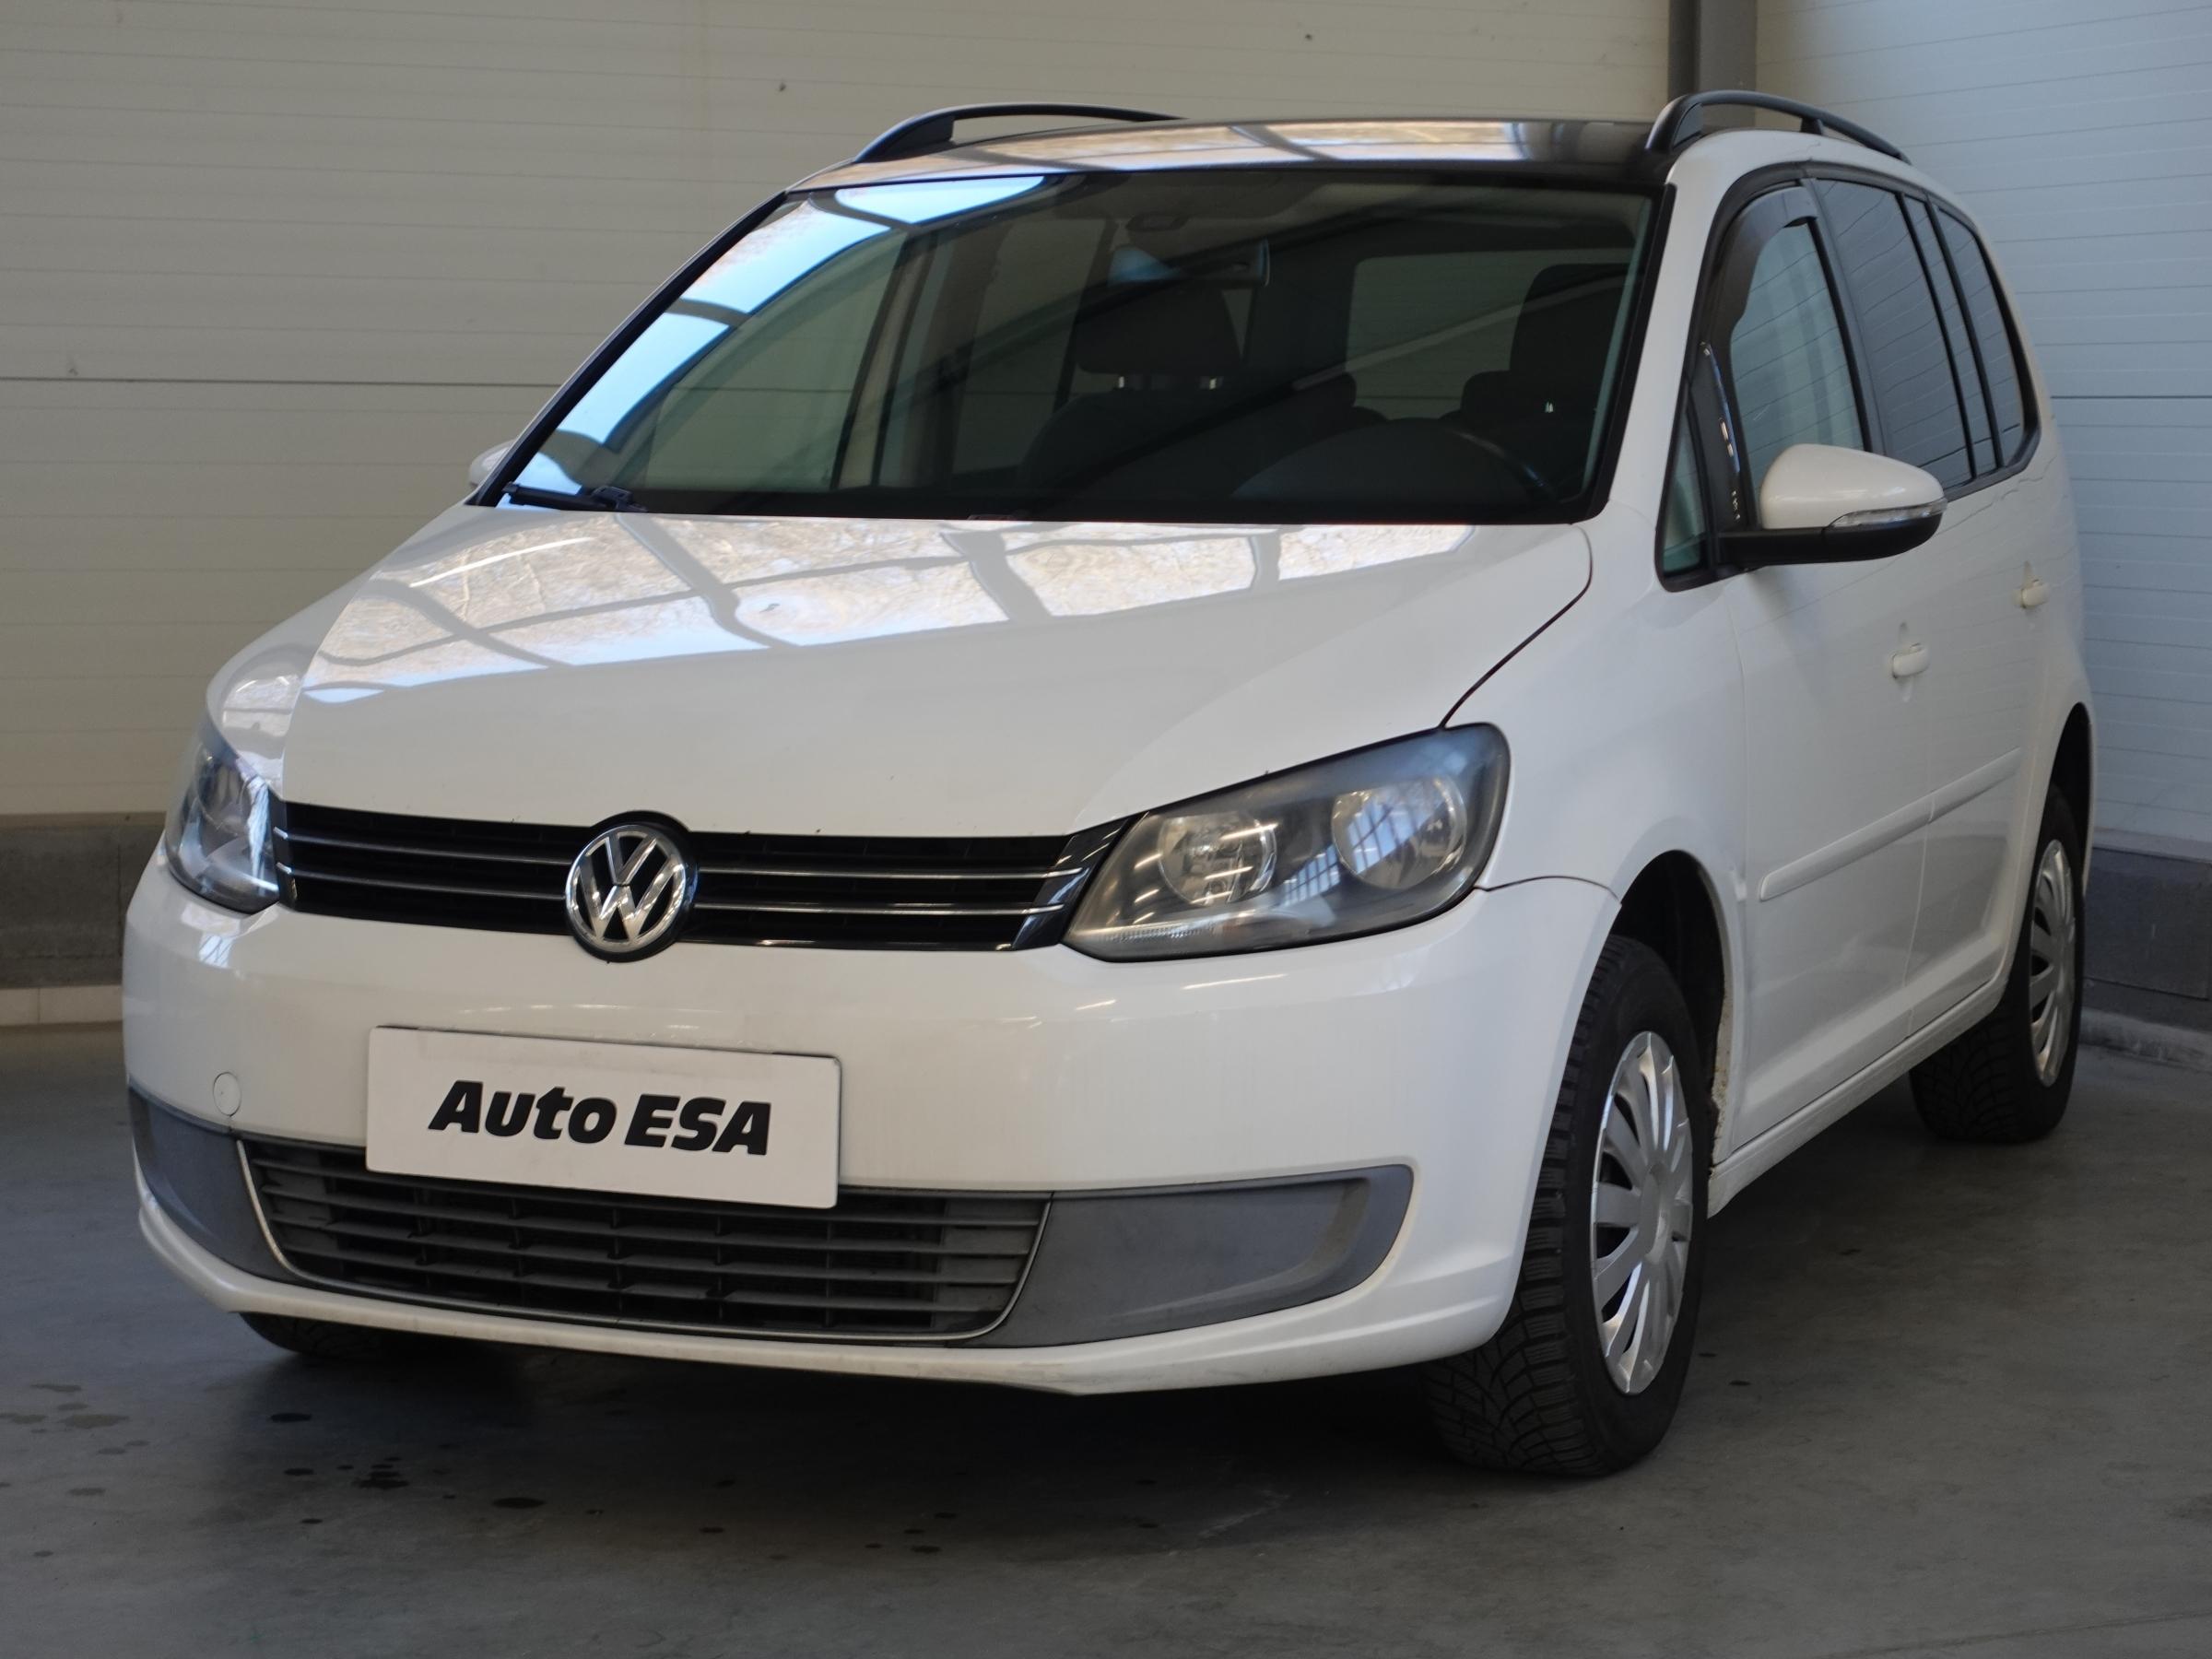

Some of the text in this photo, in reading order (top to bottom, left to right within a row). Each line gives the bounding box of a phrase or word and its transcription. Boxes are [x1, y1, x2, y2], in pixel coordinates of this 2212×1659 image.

[566, 825, 686, 952] VW
[428, 1080, 771, 1155] Auto ESA
